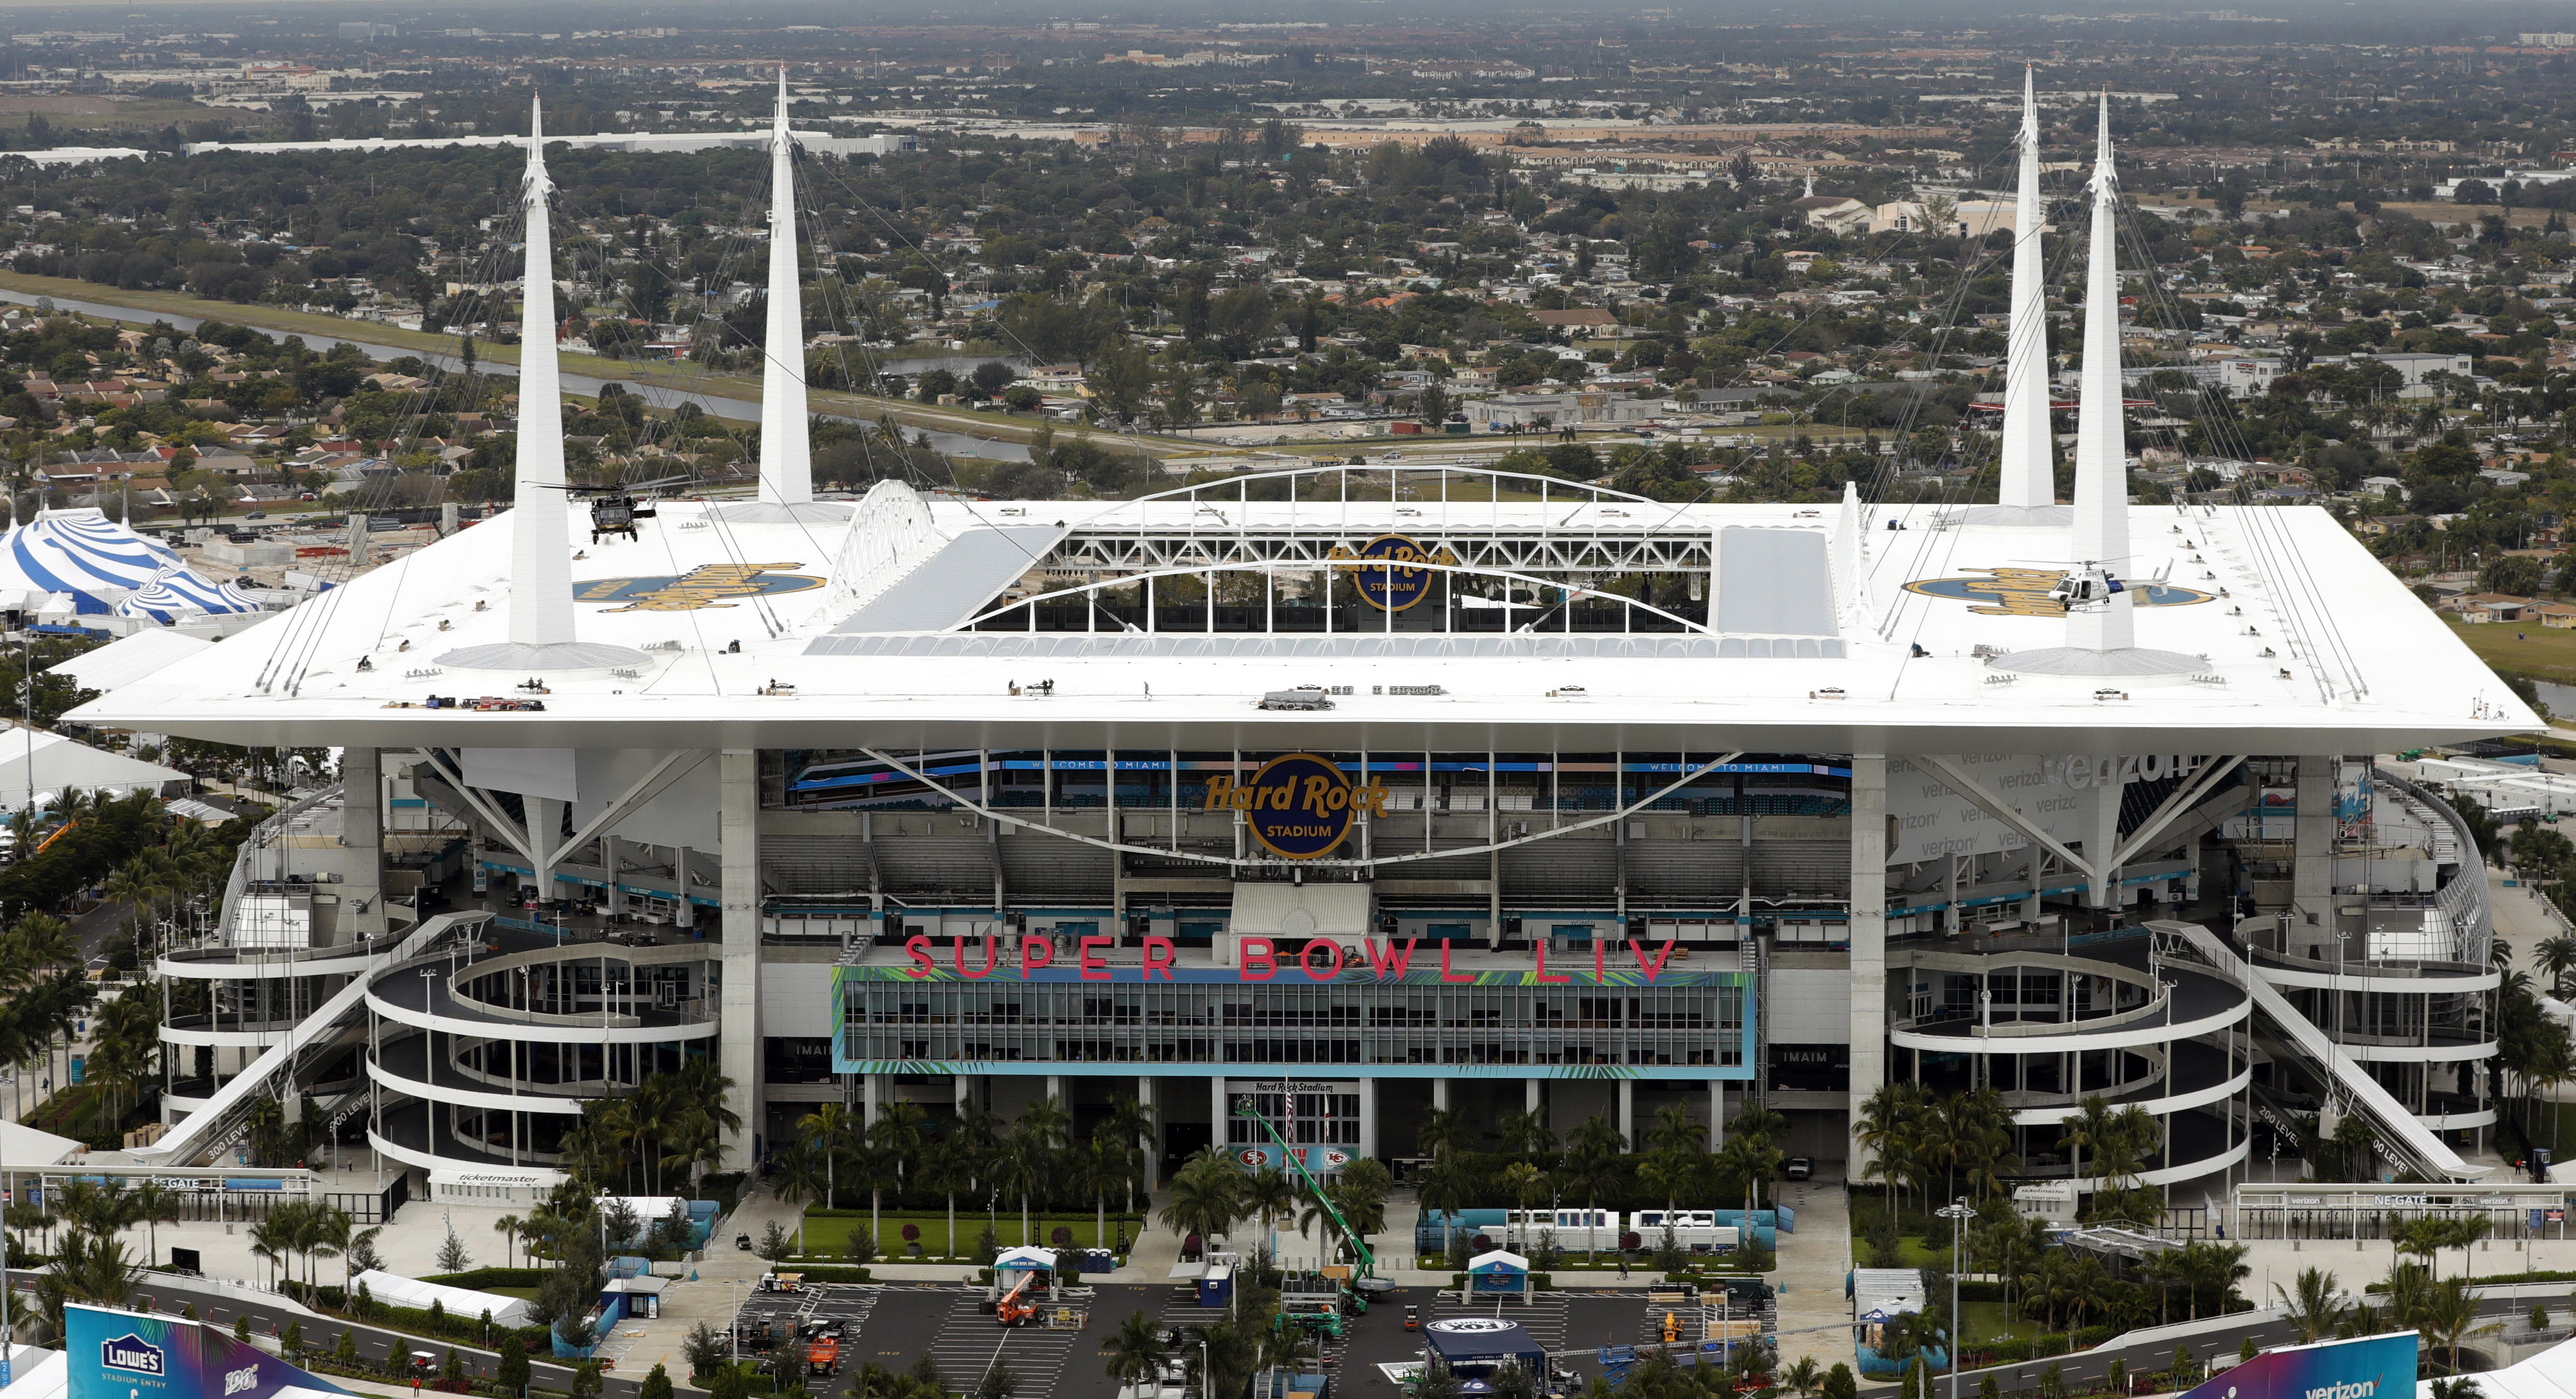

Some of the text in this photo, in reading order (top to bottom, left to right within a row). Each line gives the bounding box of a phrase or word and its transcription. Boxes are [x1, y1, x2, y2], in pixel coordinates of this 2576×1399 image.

[1328, 546, 1455, 578] Hard Rock
[1204, 775, 1390, 819] Hard Rock
[1267, 825, 1332, 837] STADIUM
[1922, 836, 1974, 856] verizon
[905, 935, 1675, 983] SUPER BOWL LIV
[1256, 1083, 1333, 1093] Hard Rock Stadium
[2259, 1106, 2276, 1124] 200
[208, 1141, 226, 1160] 300
[168, 1178, 200, 1188] GATE
[459, 1174, 539, 1183] ticketmaster
[2375, 1196, 2428, 1206] NE GATE
[109, 1345, 158, 1371] LOWE'S
[102, 1373, 167, 1389] STADIUM ENTRY
[2305, 1381, 2375, 1399] verizon
